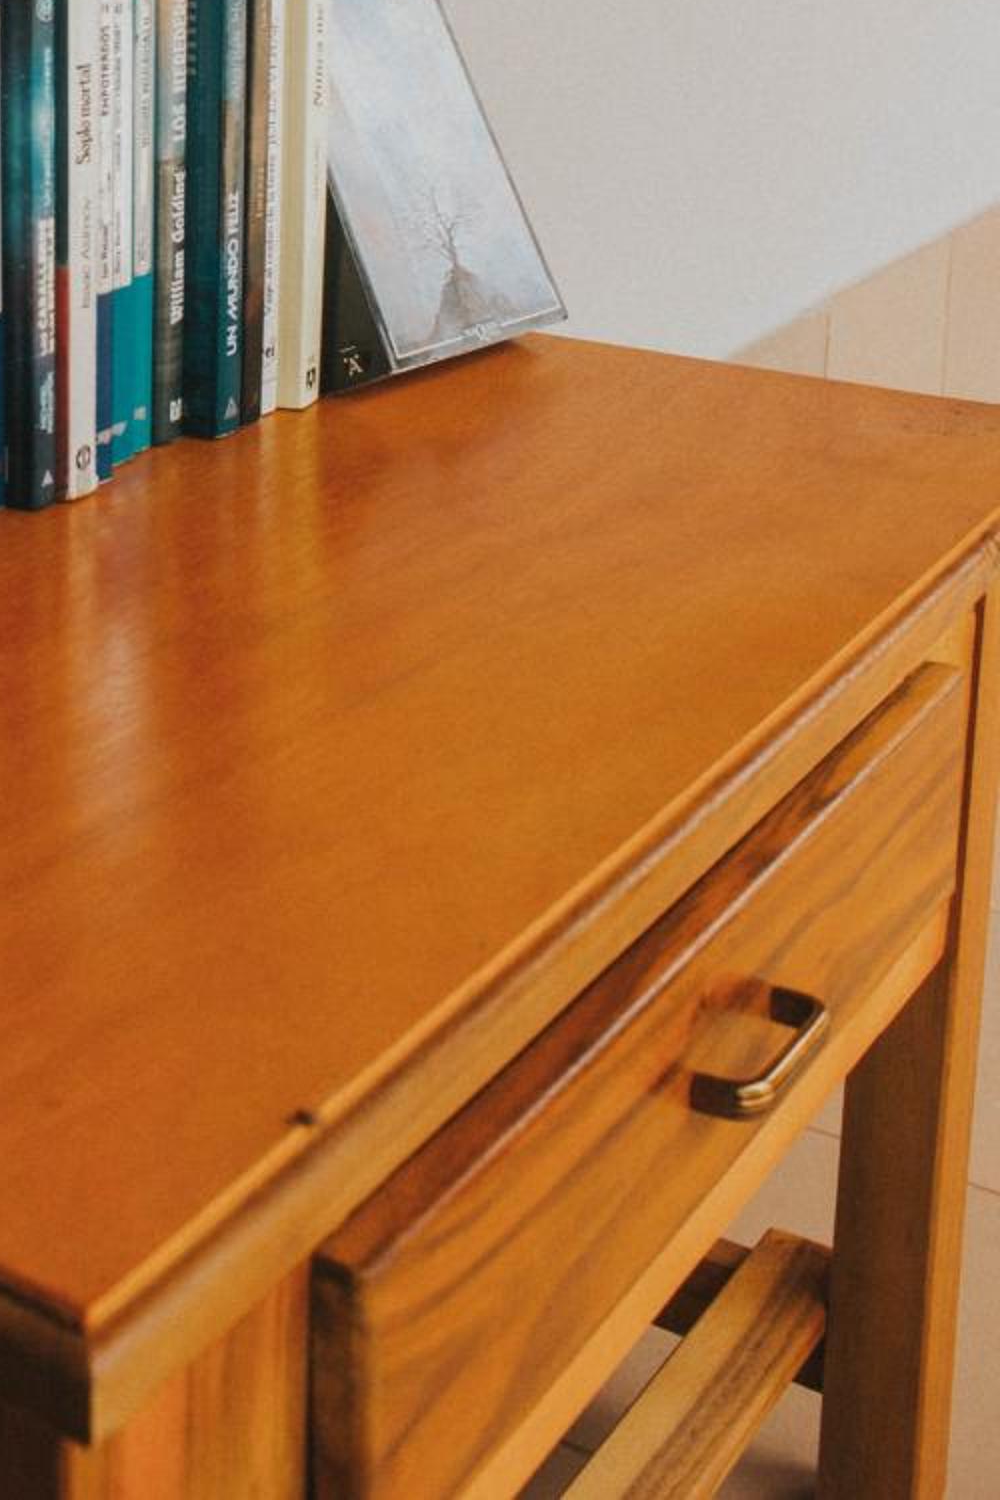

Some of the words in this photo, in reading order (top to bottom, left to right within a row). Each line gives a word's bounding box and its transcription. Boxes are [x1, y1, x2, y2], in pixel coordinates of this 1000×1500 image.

[74, 63, 91, 118] mortal
[99, 24, 110, 117] EMPOTRADOS
[75, 120, 93, 165] Soplo
[171, 103, 187, 143] LOS
[169, 170, 186, 243] Golding
[226, 190, 239, 234] FELIZ
[169, 250, 184, 324] William
[226, 240, 239, 320] MUNDO
[225, 325, 238, 357] UN
